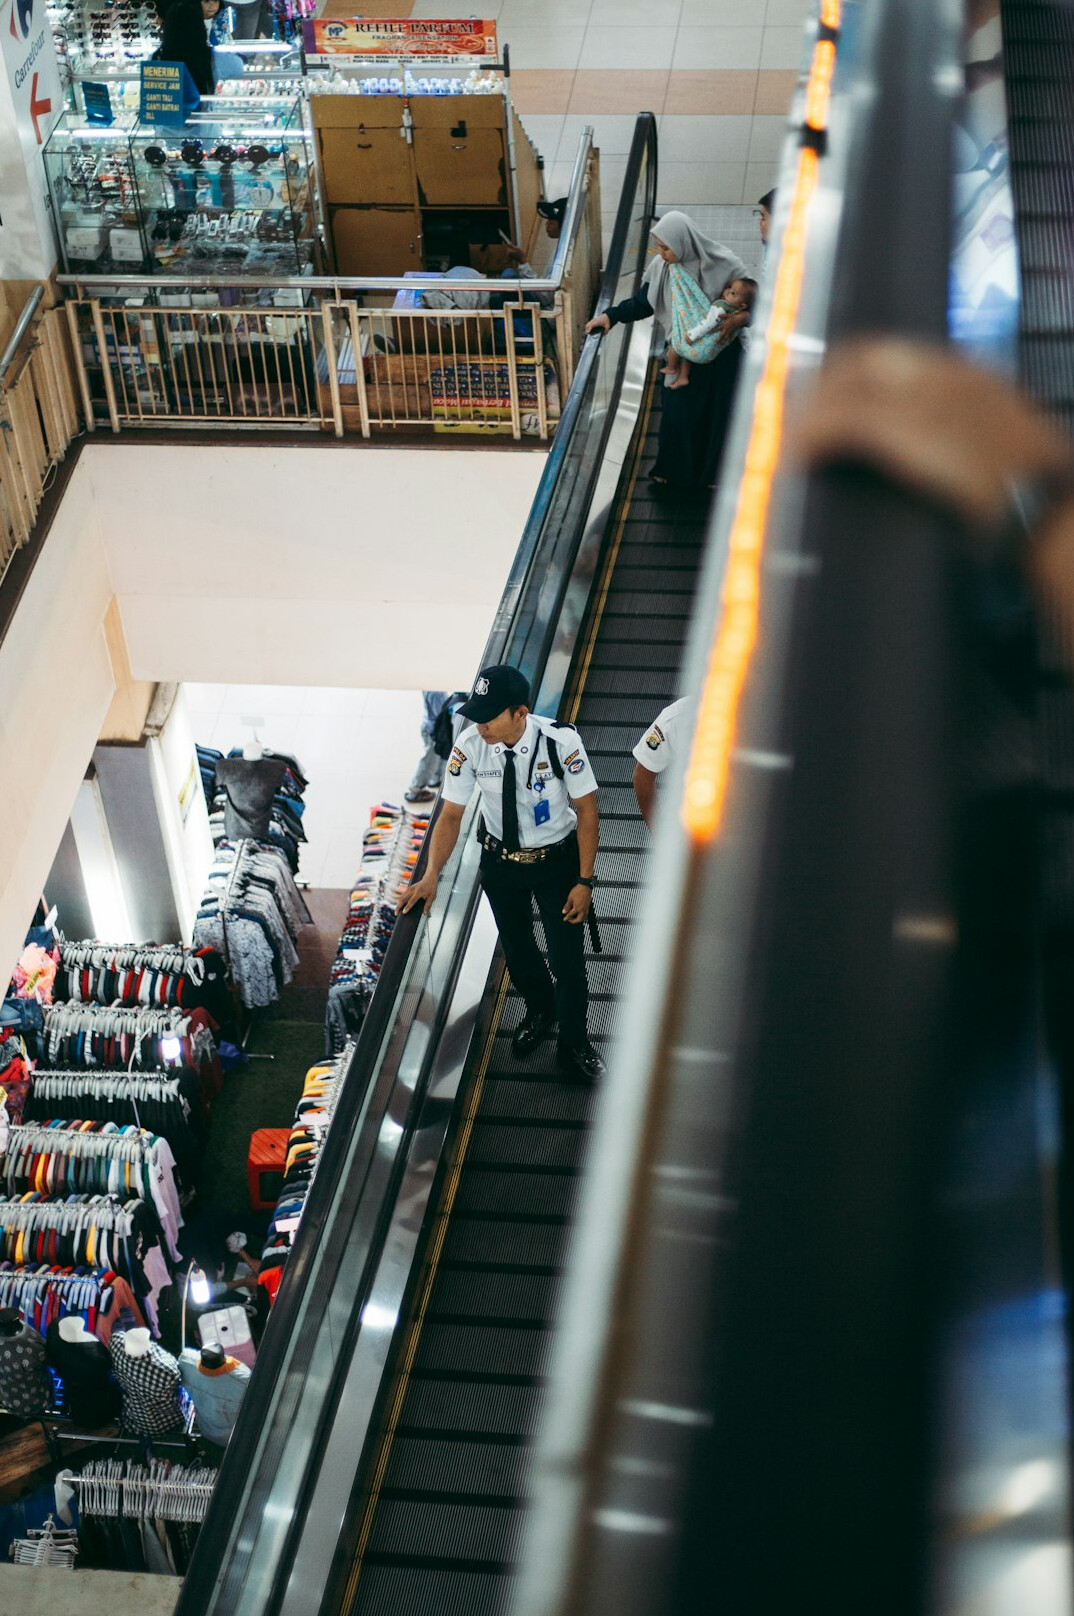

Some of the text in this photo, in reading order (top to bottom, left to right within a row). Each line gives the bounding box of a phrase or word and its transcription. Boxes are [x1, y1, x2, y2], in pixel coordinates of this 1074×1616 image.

[355, 23, 406, 33] REFILL
[410, 23, 474, 33] PARFUM
[14, 29, 46, 90] Carrefour
[143, 66, 180, 78] MENERIMA
[143, 81, 181, 90] SERVICE JAM
